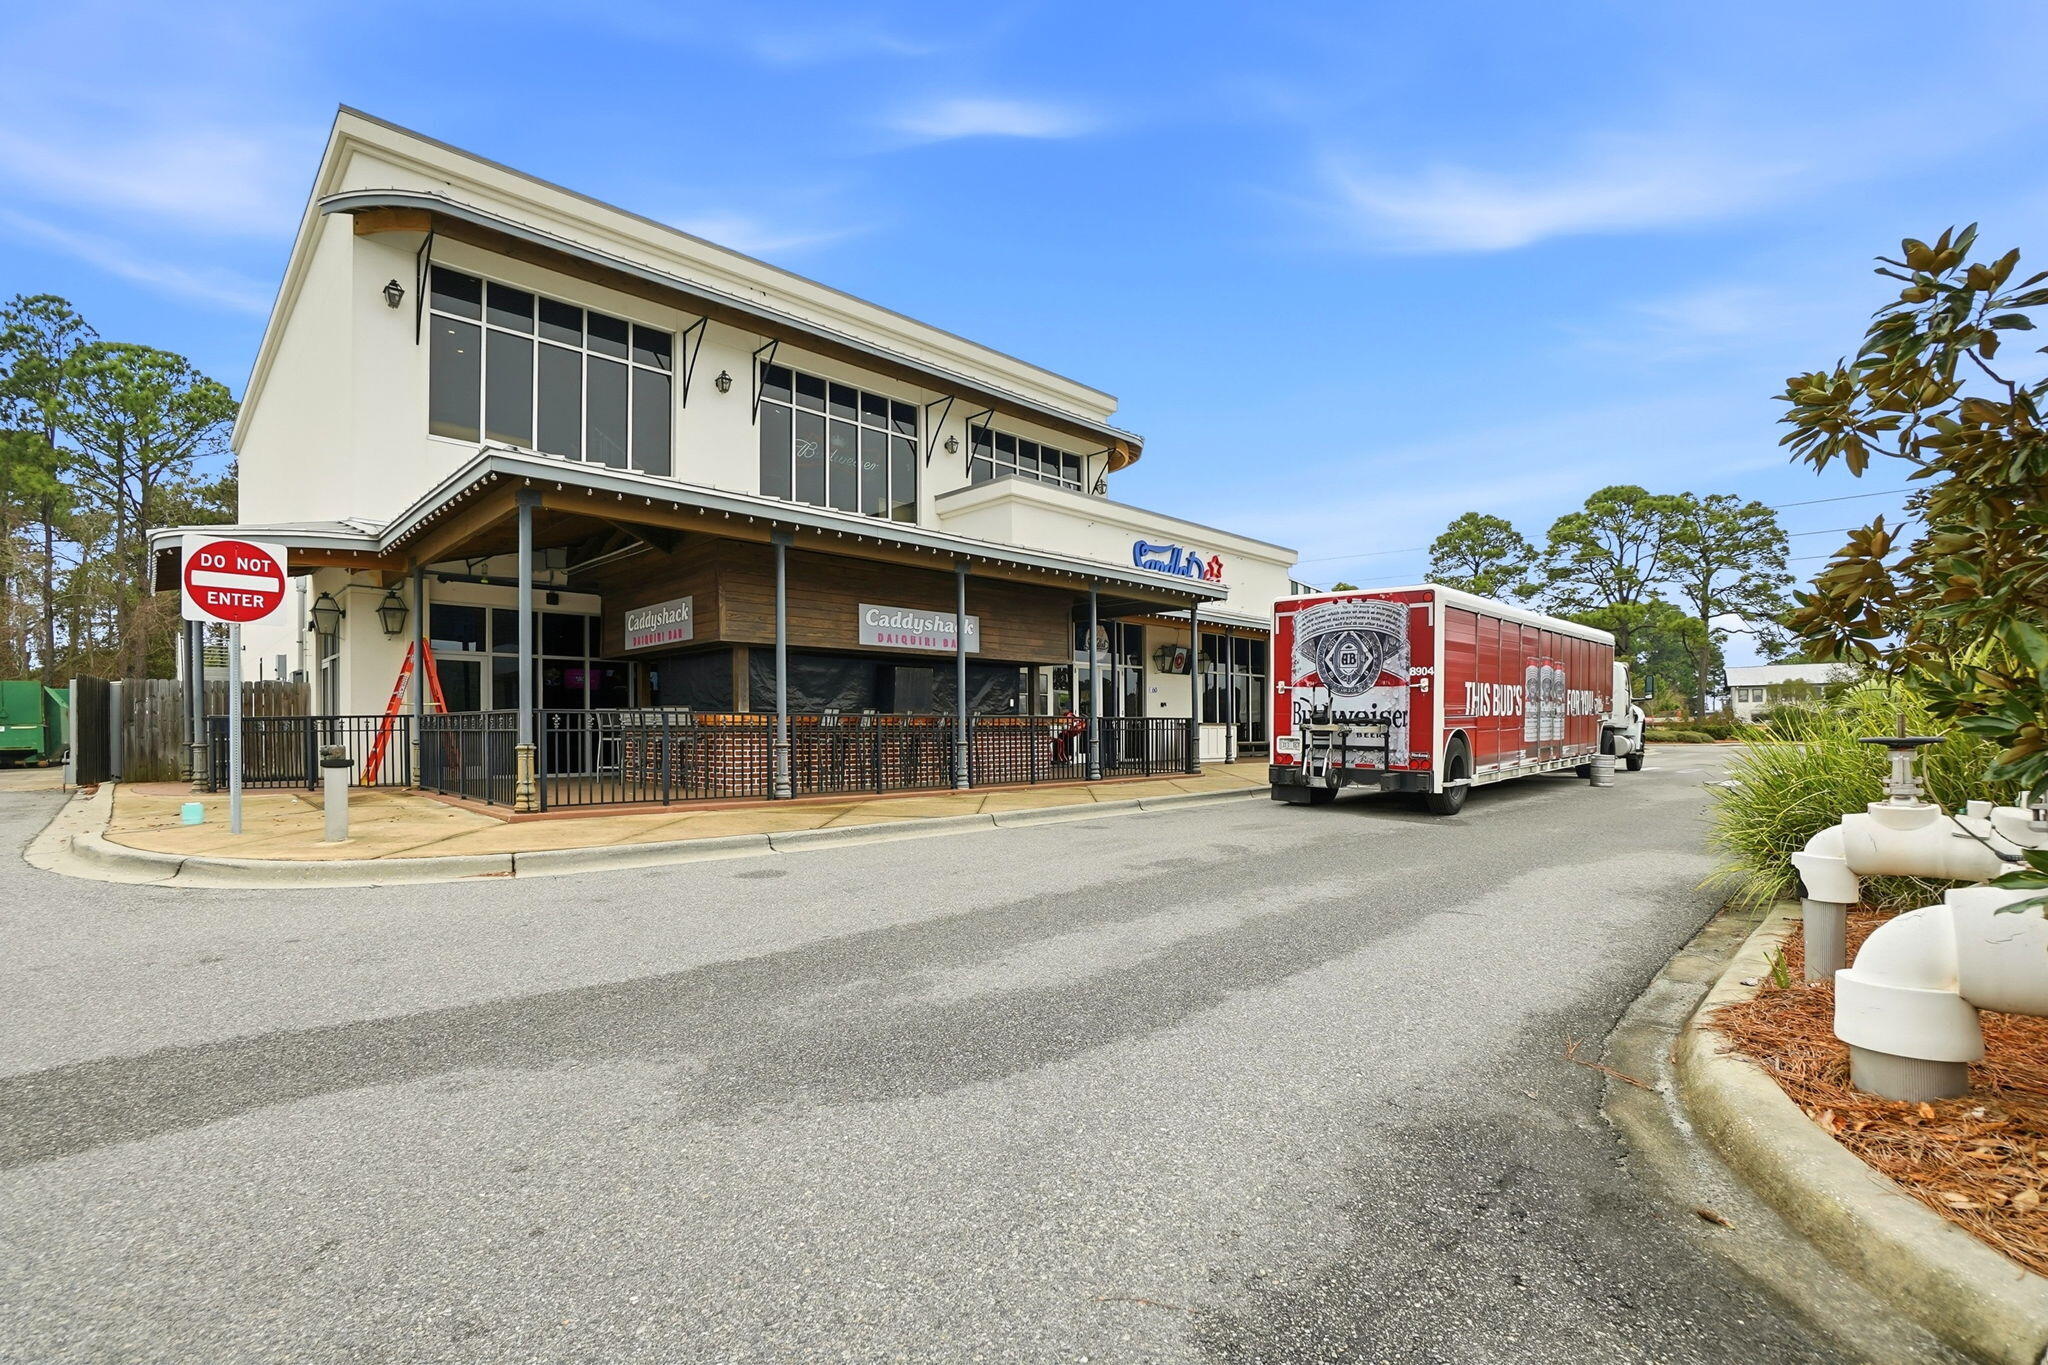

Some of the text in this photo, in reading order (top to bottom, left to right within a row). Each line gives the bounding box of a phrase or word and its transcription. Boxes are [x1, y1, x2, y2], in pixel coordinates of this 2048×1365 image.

[200, 553, 271, 573] DO NOT
[207, 591, 264, 608] ENTER
[627, 602, 689, 632] Caddyshack
[865, 608, 974, 635] Caddyshak
[668, 628, 684, 641] BAR
[877, 632, 958, 649] DAIQUIRI BA
[1409, 666, 1434, 676] 8904
[1465, 682, 1490, 717] THIS
[1493, 684, 1523, 717] BUD'S
[1567, 689, 1580, 715] FOR
[1293, 701, 1408, 729] Buweiser
